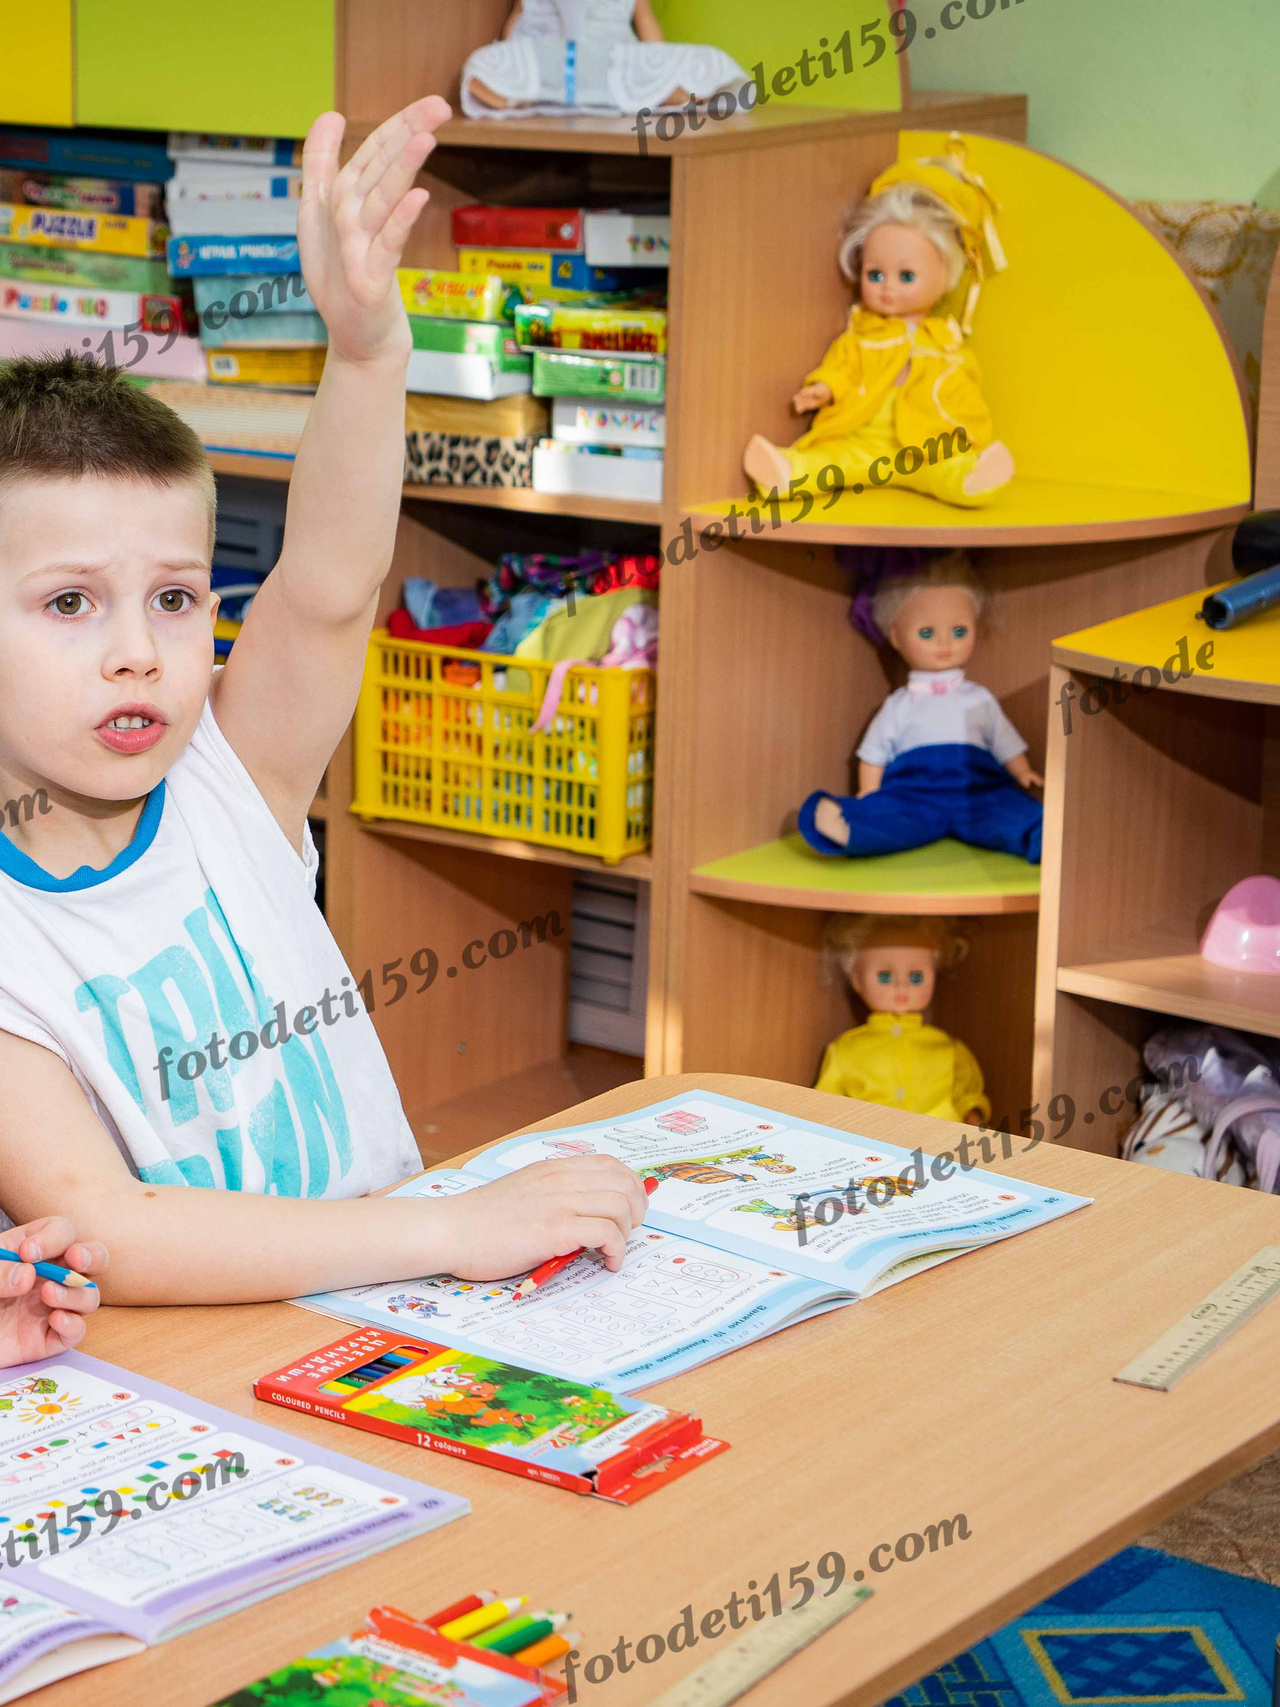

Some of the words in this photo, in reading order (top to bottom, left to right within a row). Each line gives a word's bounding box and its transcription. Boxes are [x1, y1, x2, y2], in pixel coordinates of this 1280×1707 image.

[30, 211, 98, 239] PUZZLE
[728, 1304, 767, 1329] Занятие
[709, 1330, 727, 1339] 19.
[276, 1331, 381, 1383] КАРАНДАШИ
[307, 1339, 386, 1379] ЦВЕТНЫЕ
[656, 1339, 709, 1362] Измерение
[271, 1392, 311, 1410] COLOURED
[315, 1405, 346, 1420] PENCILS
[416, 1433, 431, 1448] 12
[433, 1440, 467, 1456] colours
